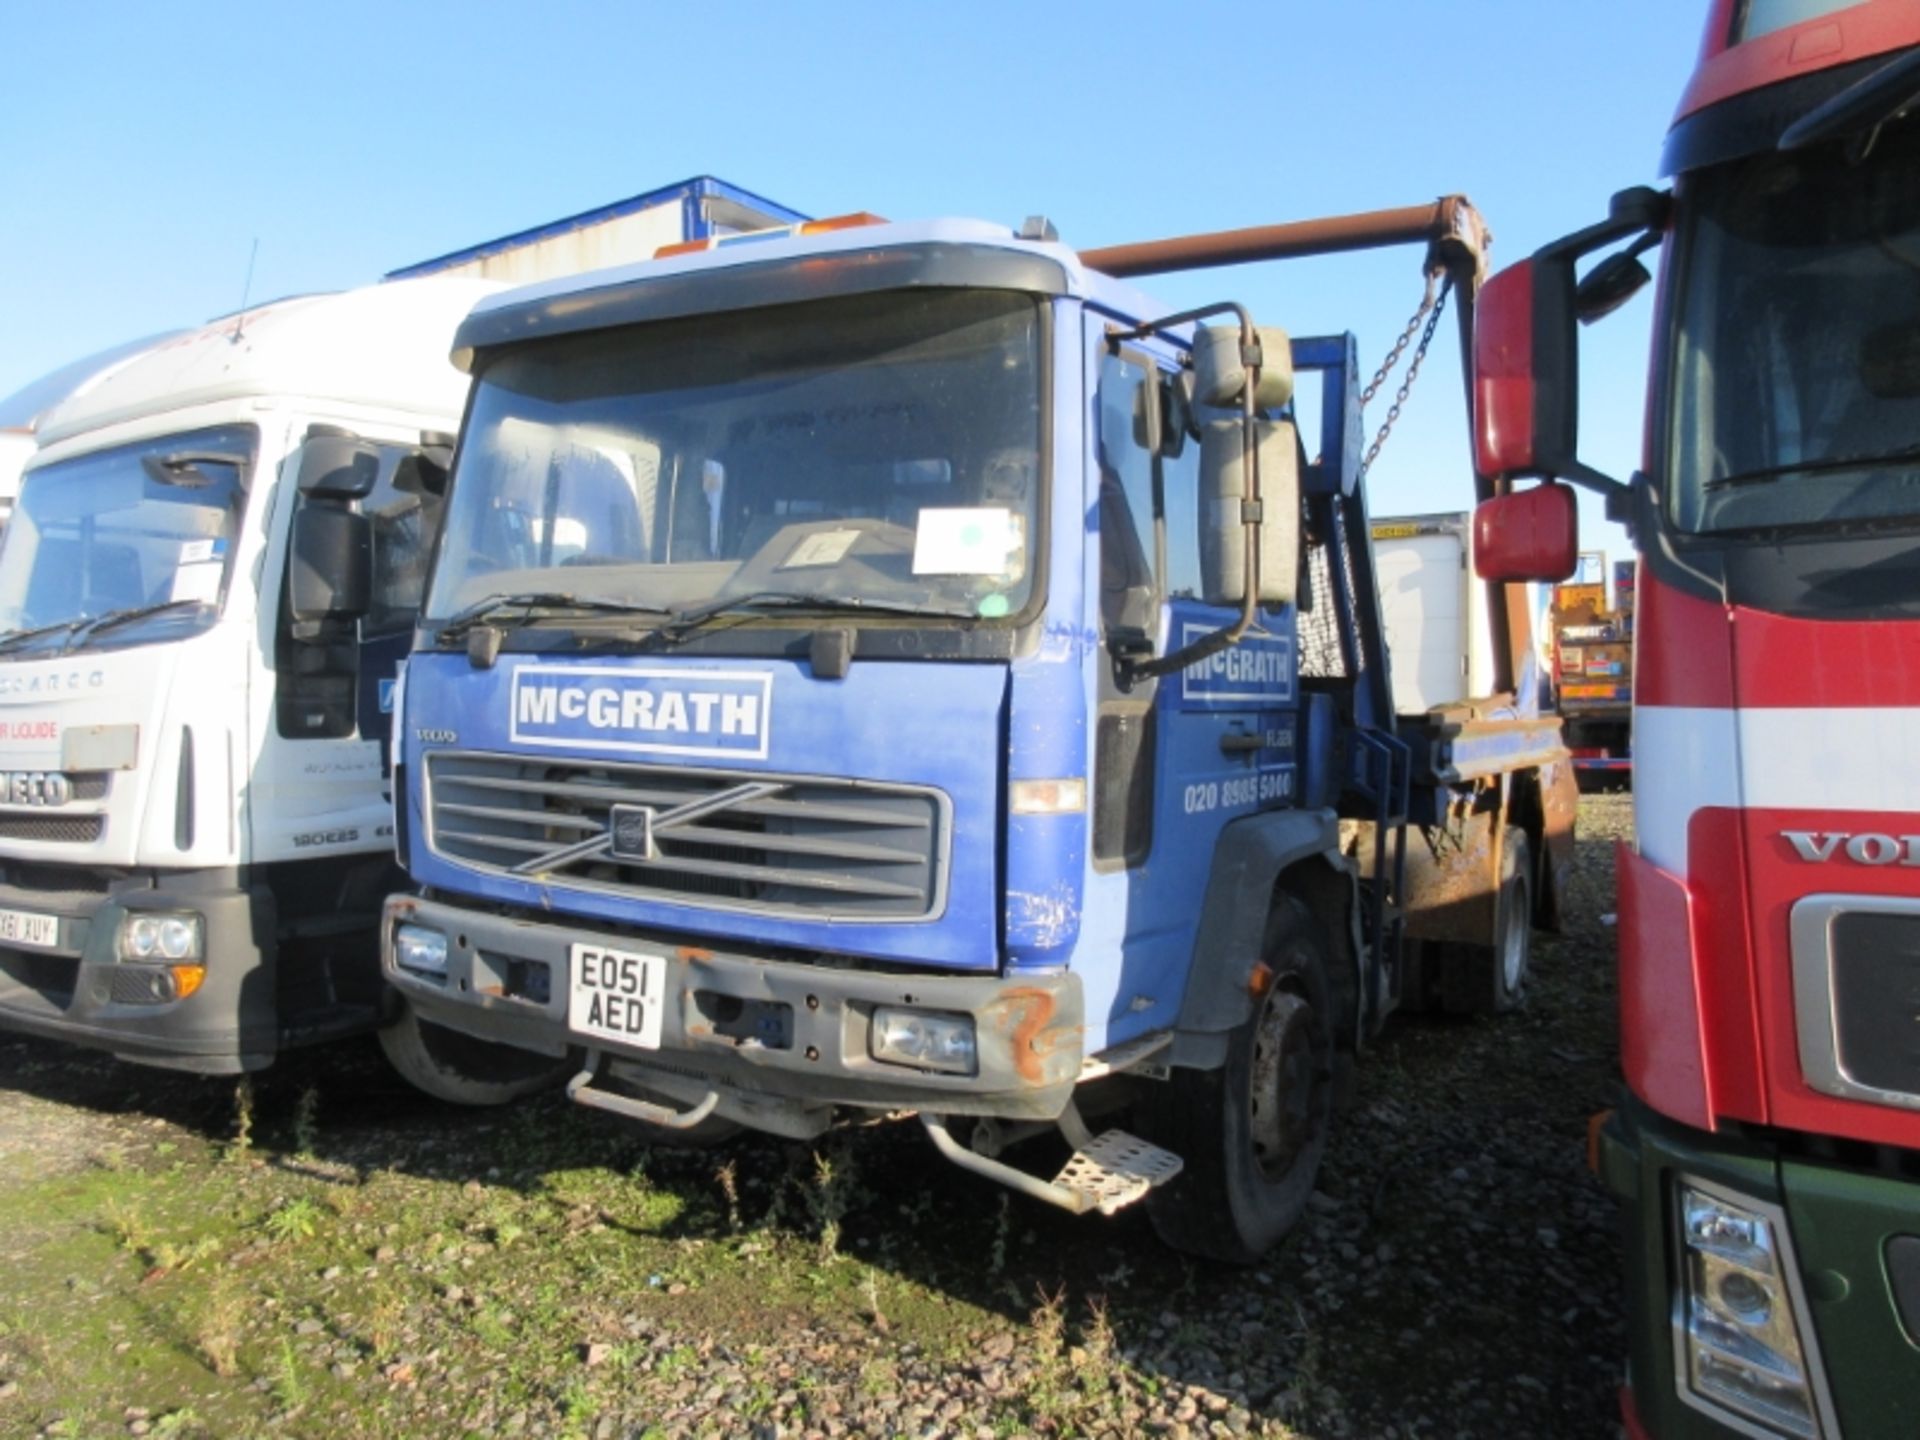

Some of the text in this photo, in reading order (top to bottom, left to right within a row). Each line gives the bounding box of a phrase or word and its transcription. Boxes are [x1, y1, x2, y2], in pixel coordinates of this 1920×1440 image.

[519, 686, 758, 735] McGRATH
[1184, 783, 1217, 814] 020
[581, 952, 648, 997] EO51
[588, 991, 644, 1034] AED
